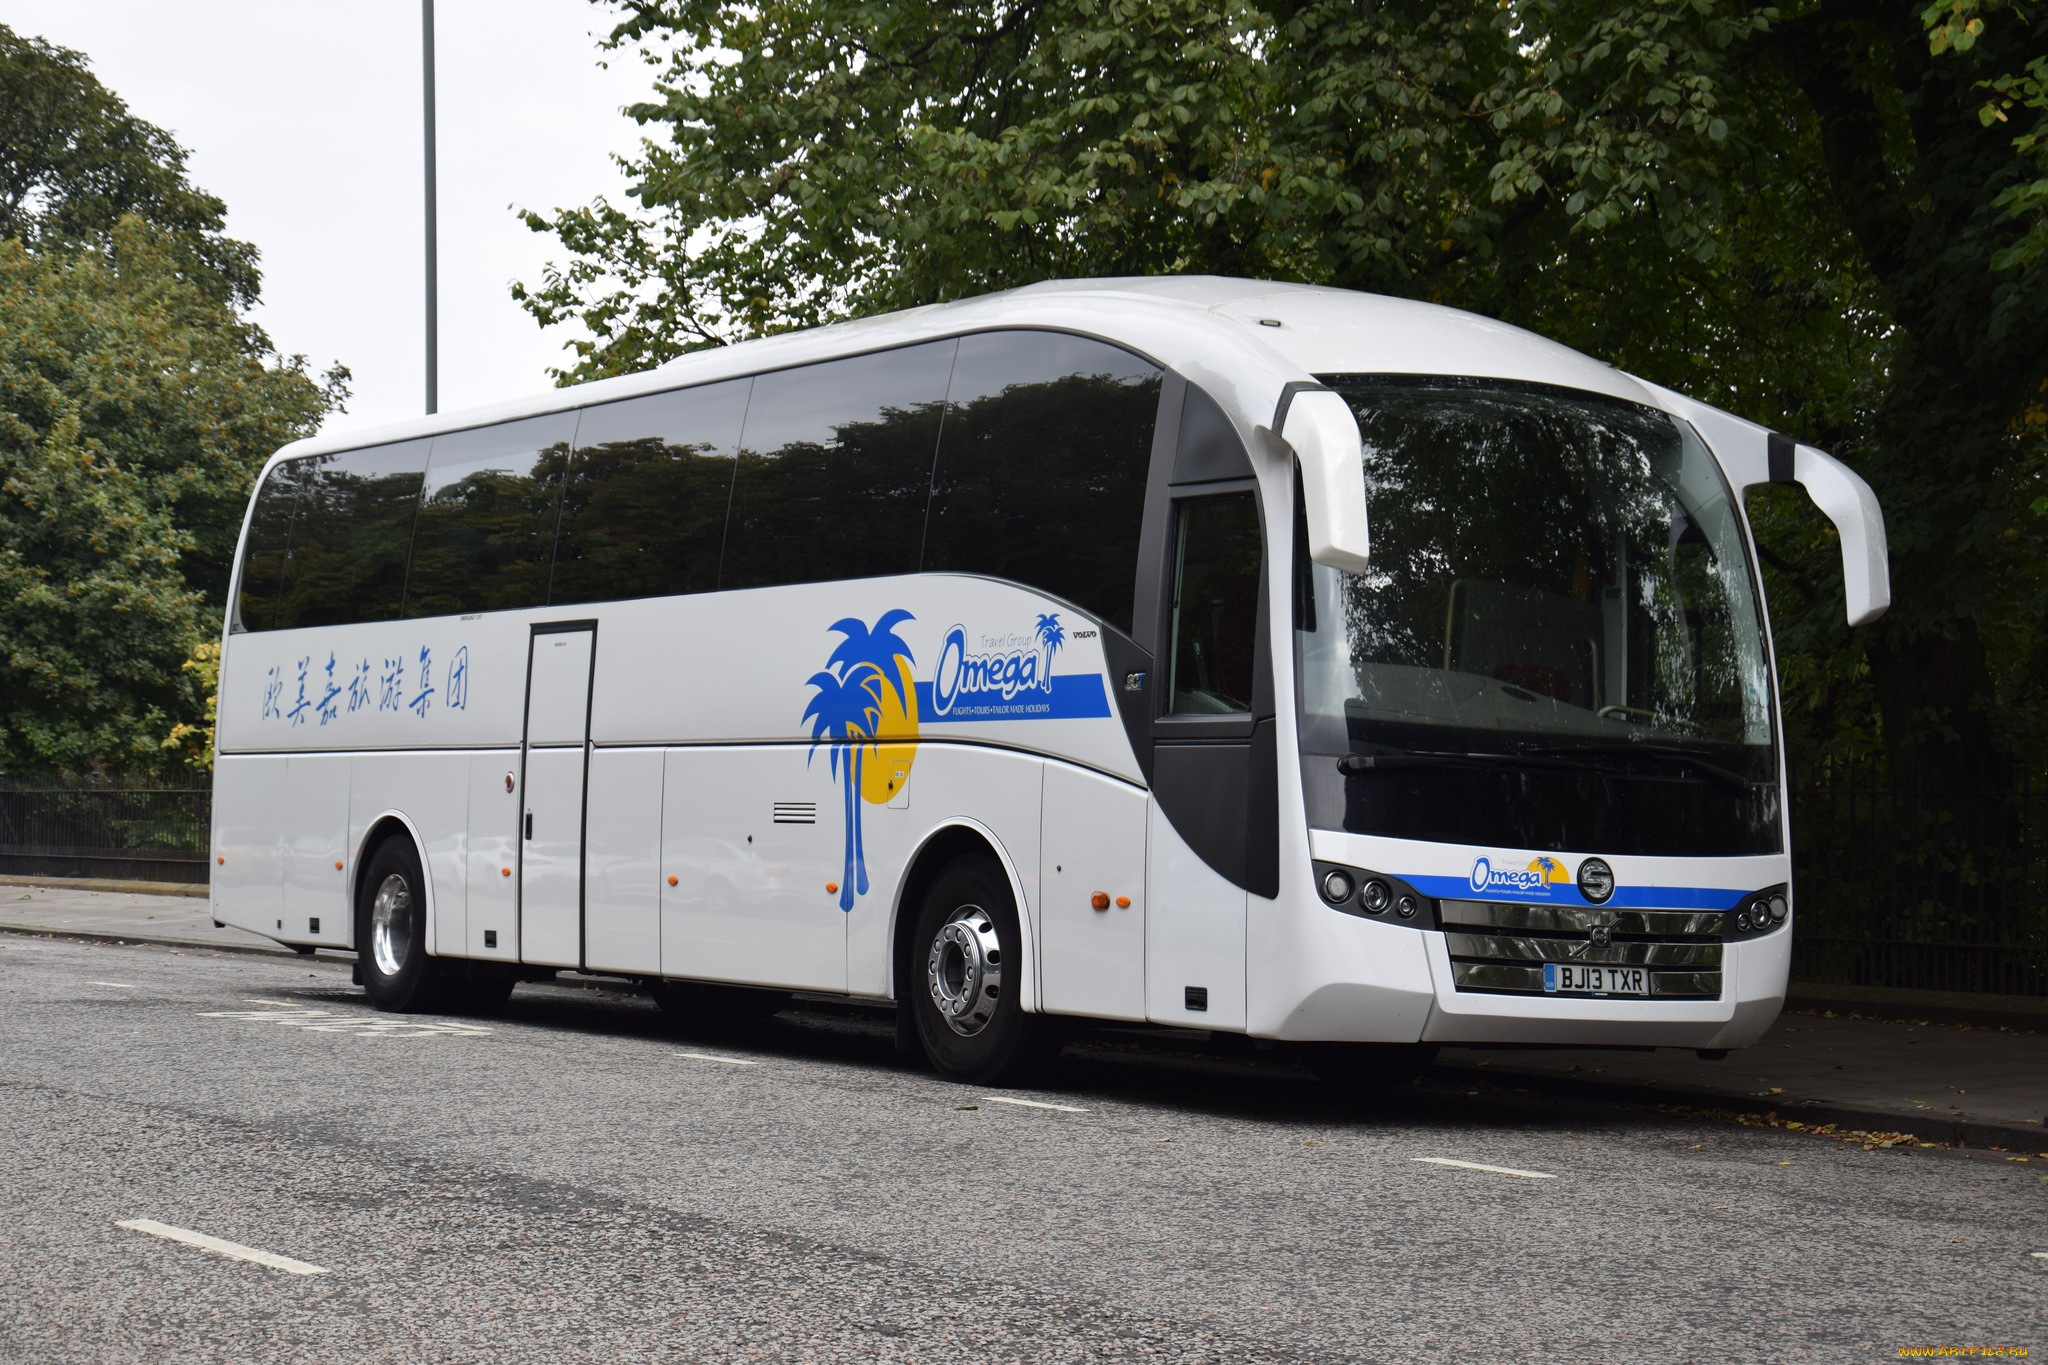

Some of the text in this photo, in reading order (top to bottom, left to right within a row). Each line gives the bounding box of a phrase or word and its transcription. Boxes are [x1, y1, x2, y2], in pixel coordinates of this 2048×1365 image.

[981, 633, 1032, 650] Travel Group
[1073, 630, 1097, 639] VOLVO
[933, 624, 1040, 715] Omega
[1010, 704, 1025, 714] MADE
[1026, 703, 1050, 713] HOLIDAYS
[1470, 855, 1541, 892] Omega
[1561, 967, 1643, 991] BJ13 TXR
